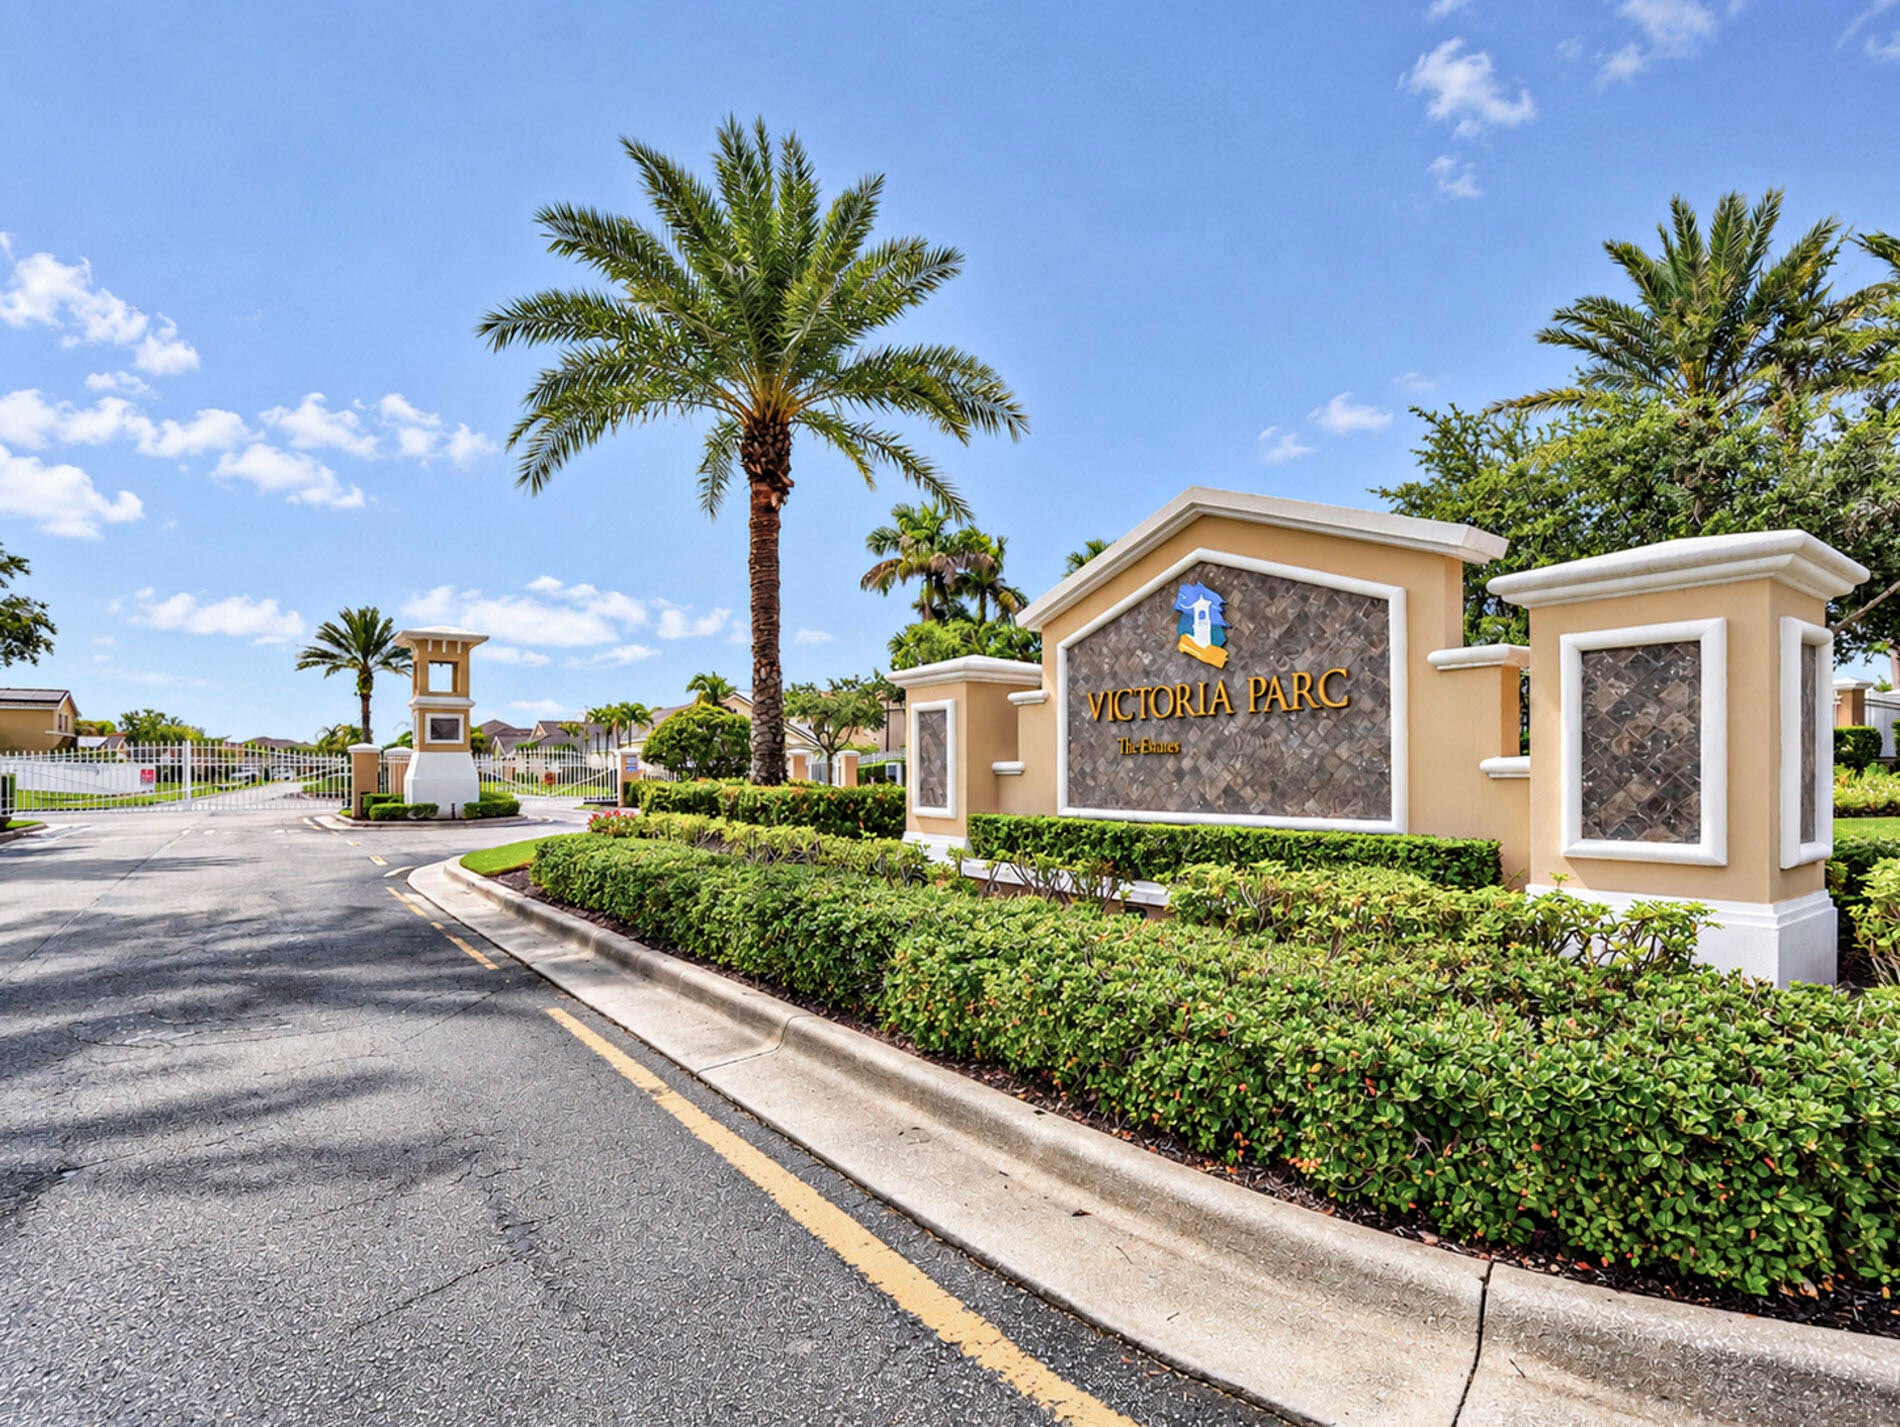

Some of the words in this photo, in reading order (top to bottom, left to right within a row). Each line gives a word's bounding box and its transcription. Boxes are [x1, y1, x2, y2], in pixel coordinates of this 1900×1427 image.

[1087, 679, 1233, 722] VICTORIA
[1247, 668, 1349, 713] PARC
[1117, 737, 1137, 755] The
